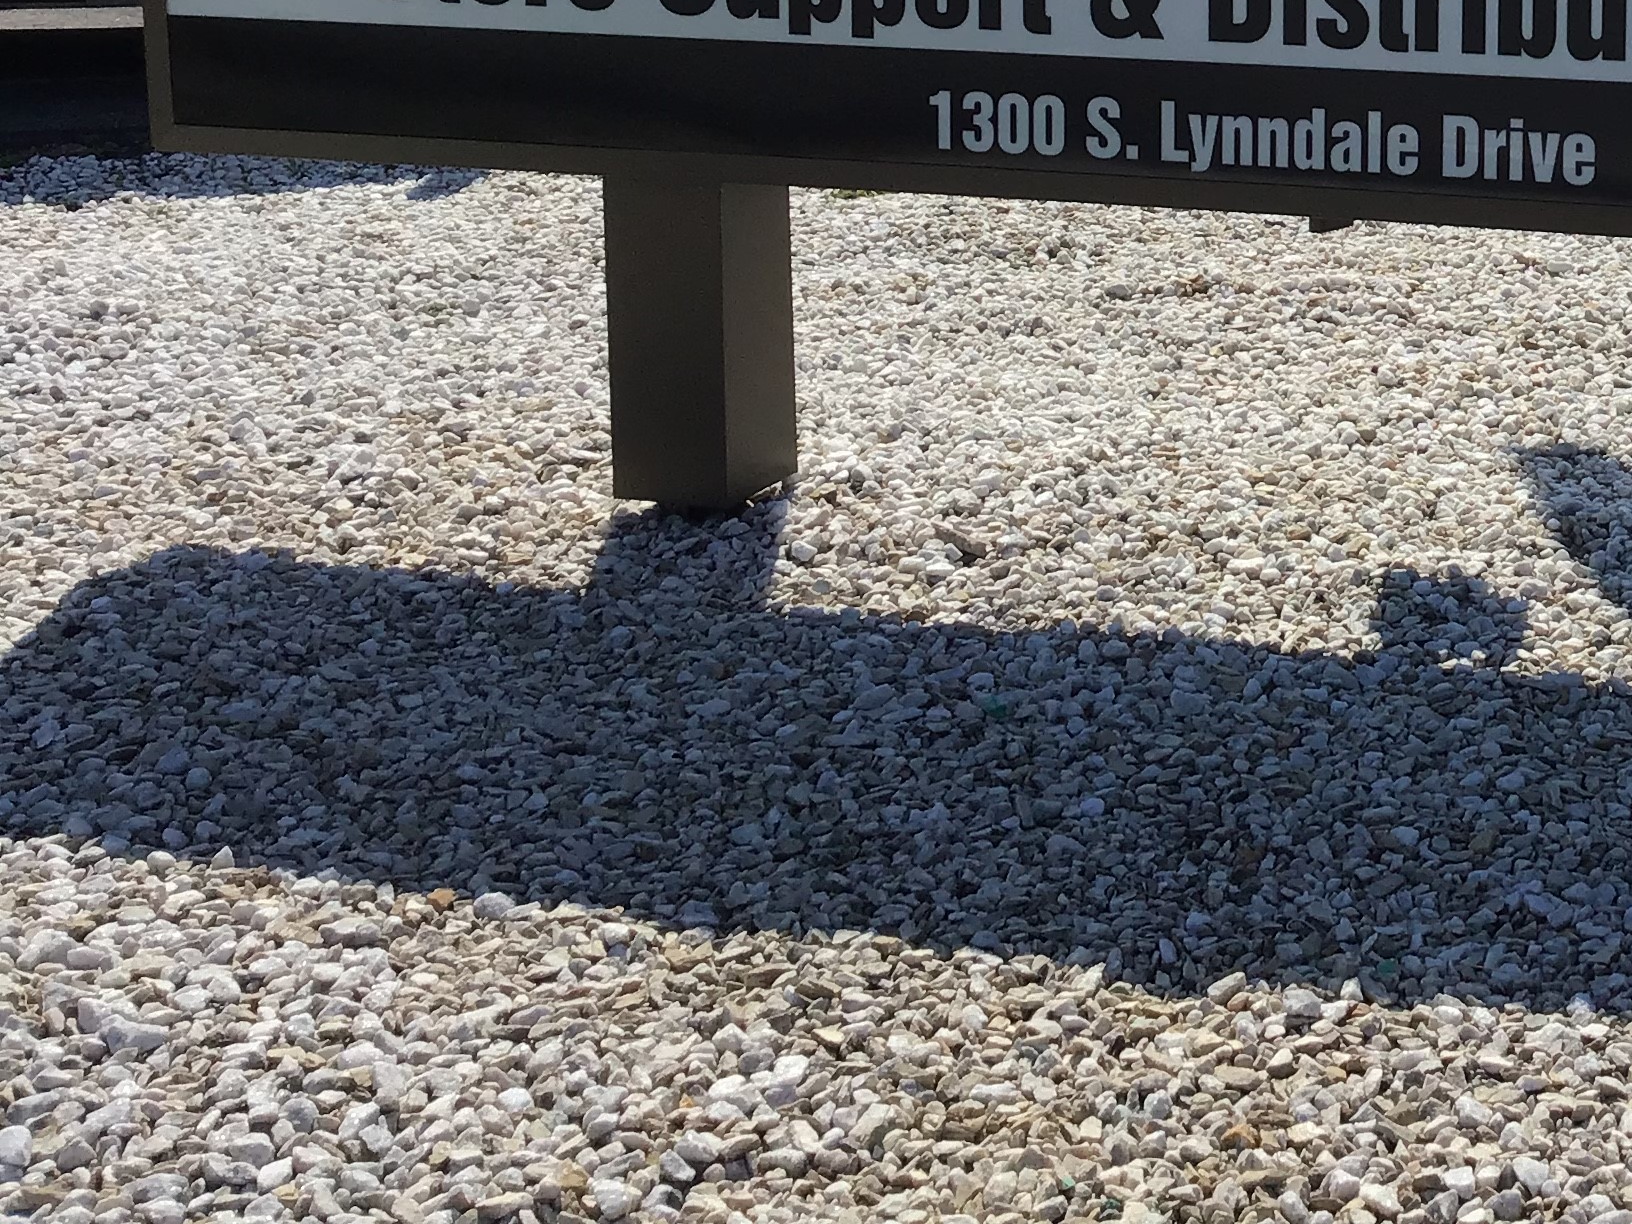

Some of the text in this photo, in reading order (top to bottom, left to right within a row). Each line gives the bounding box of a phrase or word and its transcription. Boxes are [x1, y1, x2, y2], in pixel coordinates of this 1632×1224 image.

[929, 89, 1597, 186] 1300 S. Lynndale Drive
